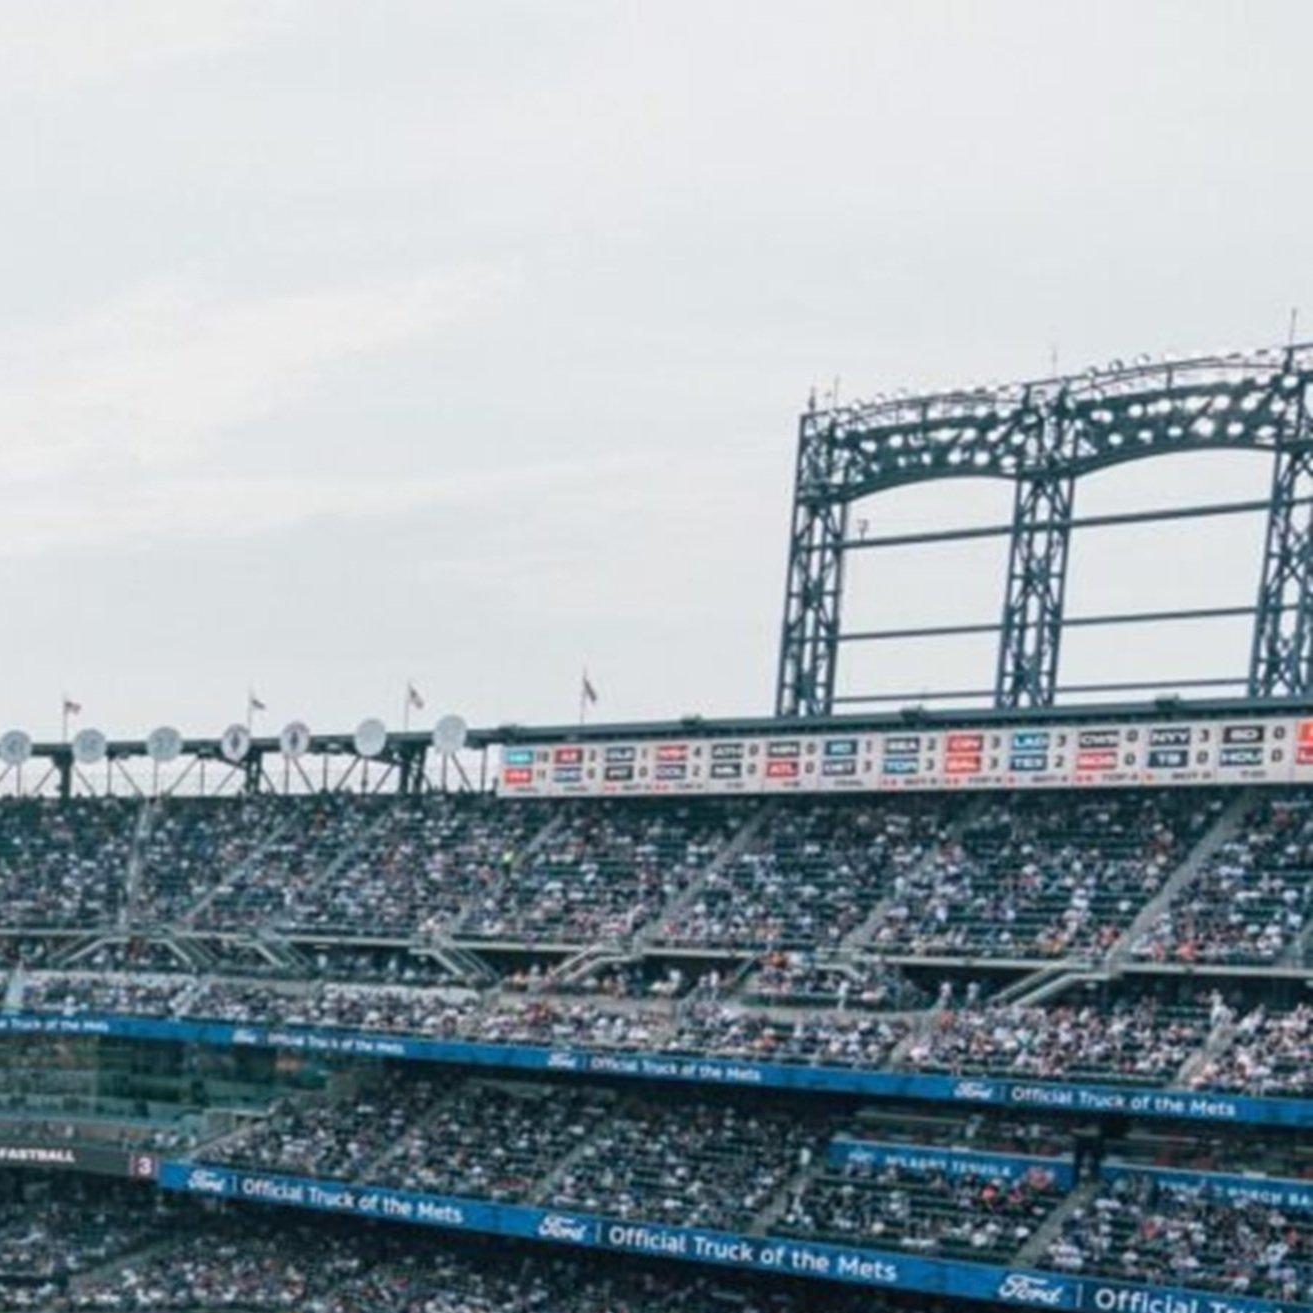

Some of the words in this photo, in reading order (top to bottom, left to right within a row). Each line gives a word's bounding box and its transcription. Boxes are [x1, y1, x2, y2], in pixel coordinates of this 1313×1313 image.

[1011, 1087, 1073, 1105] Official
[1079, 1091, 1124, 1108] Truck
[1131, 1094, 1149, 1109] of
[1155, 1095, 1184, 1112] the
[1190, 1099, 1236, 1116] Mets
[138, 1156, 152, 1175] 3
[242, 1178, 303, 1201] Official
[310, 1187, 354, 1208] Truck
[359, 1195, 377, 1211] of
[383, 1198, 412, 1217] the
[418, 1202, 463, 1224] Mets
[539, 1215, 587, 1241] Ford
[609, 1225, 687, 1255] Official
[693, 1236, 754, 1264] Truck
[760, 1245, 785, 1266] of
[791, 1248, 830, 1273] the
[837, 1255, 896, 1283] Mets
[999, 1274, 1064, 1305] Ford
